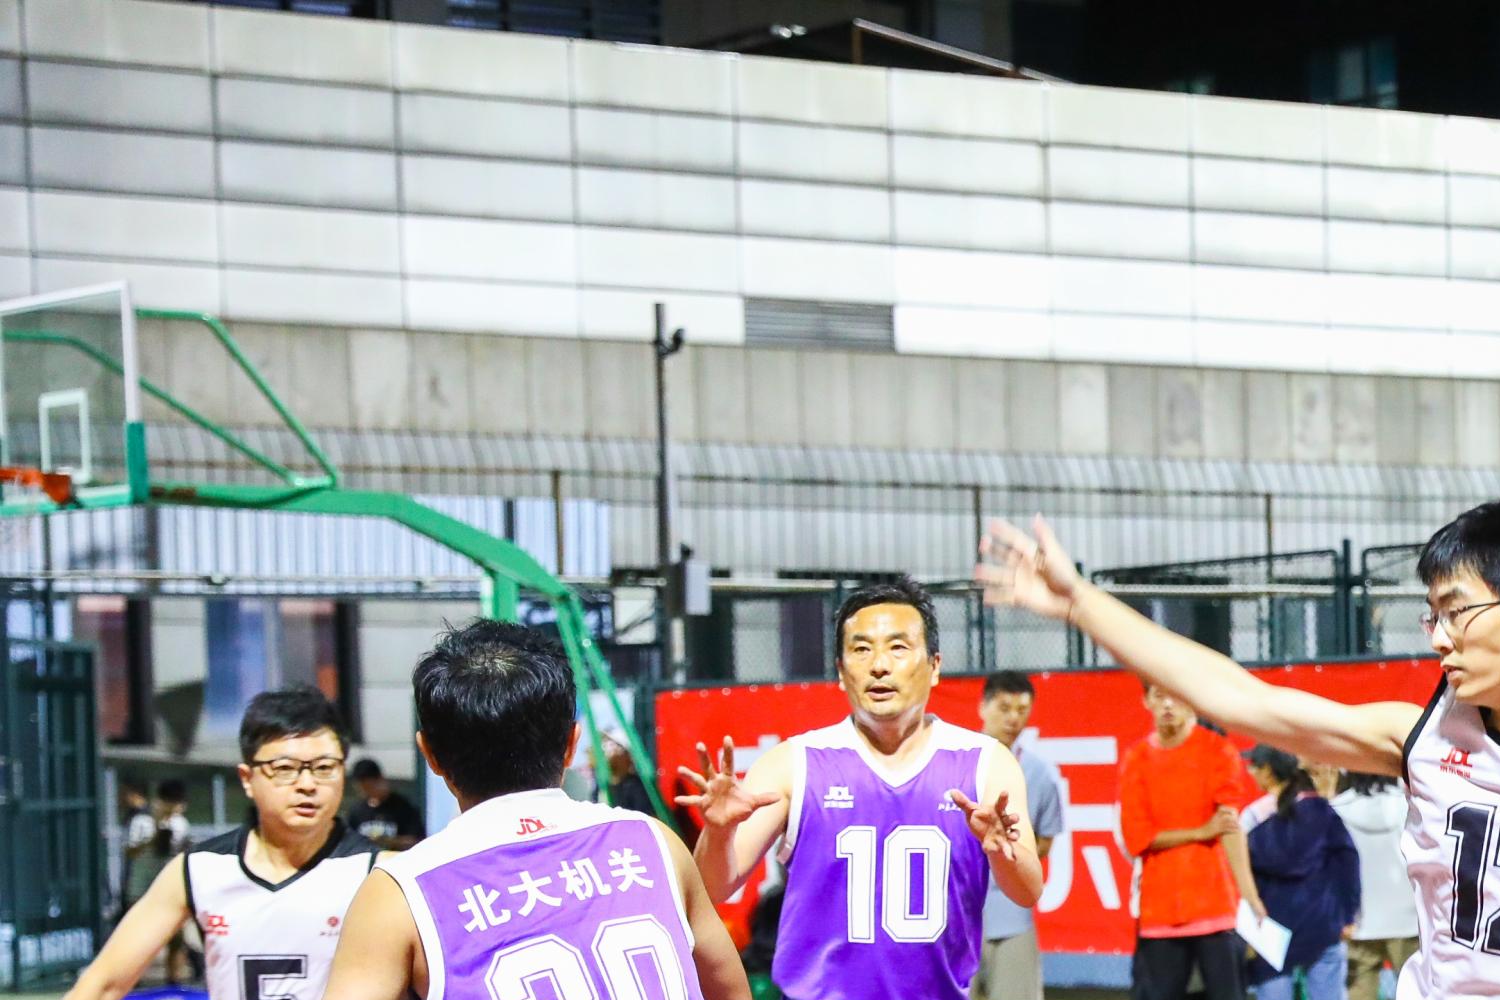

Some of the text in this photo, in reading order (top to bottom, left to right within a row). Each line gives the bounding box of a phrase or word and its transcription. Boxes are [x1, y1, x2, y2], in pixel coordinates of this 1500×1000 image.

[458, 846, 654, 935] 北大机关
[836, 825, 950, 944] 10
